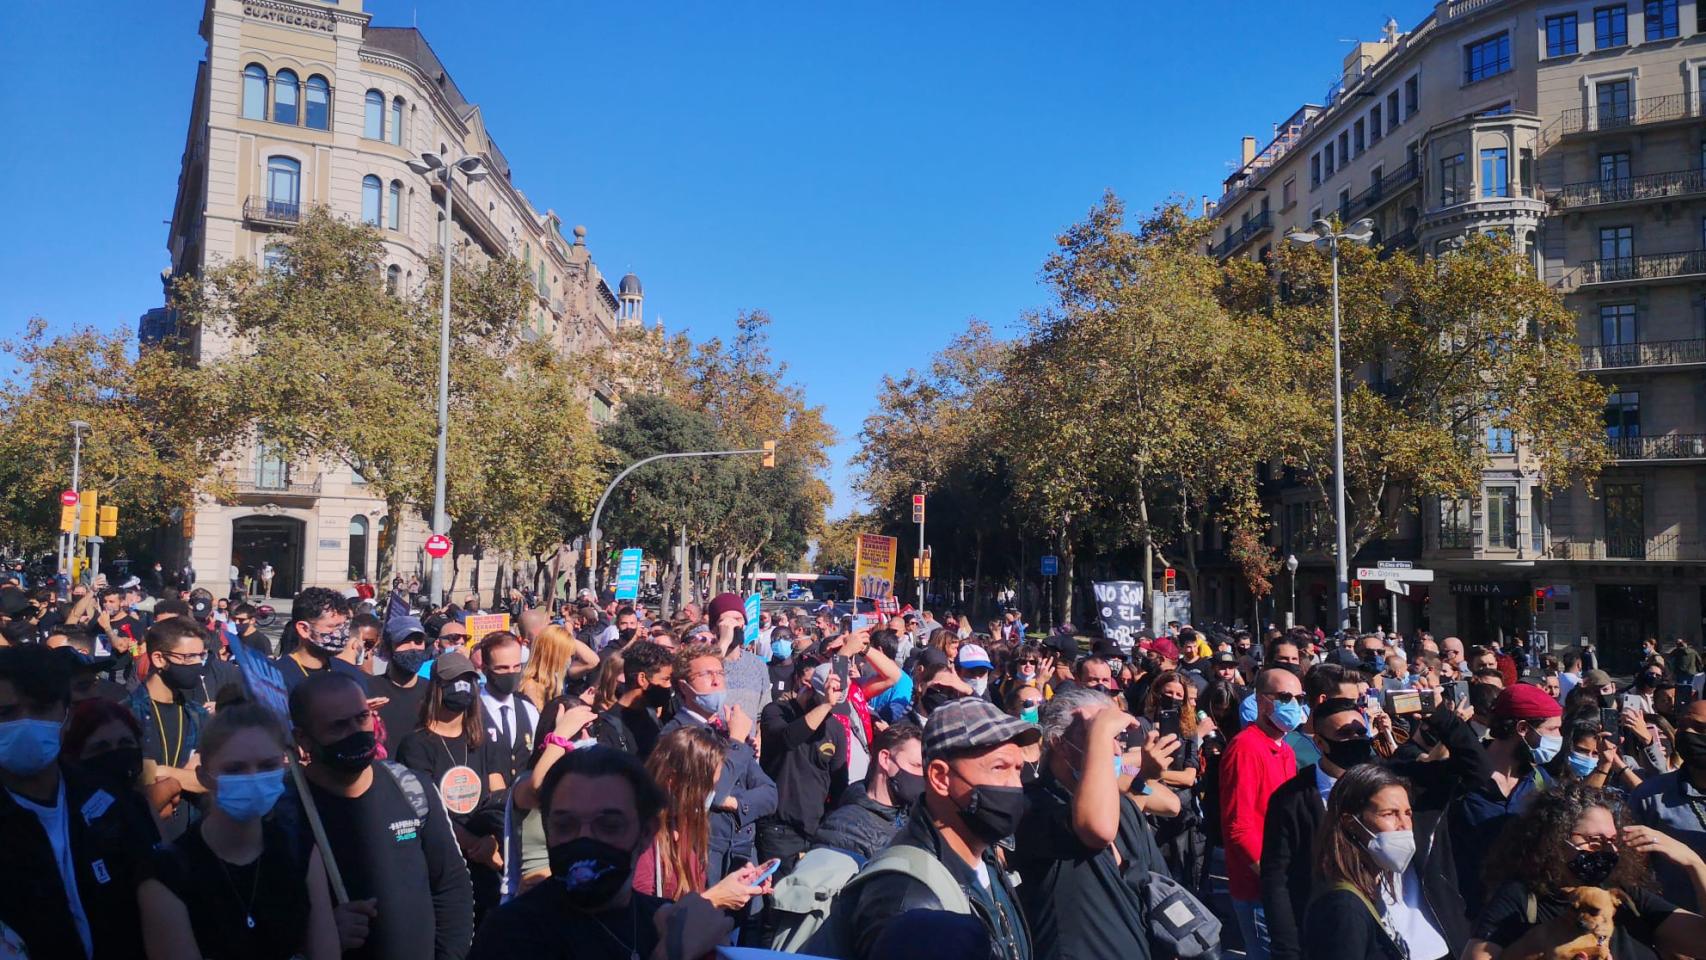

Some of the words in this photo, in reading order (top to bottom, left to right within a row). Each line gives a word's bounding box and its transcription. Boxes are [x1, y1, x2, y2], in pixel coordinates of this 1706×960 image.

[243, 7, 335, 32] CUATRECASAS
[1094, 584, 1117, 602] NO
[1118, 605, 1141, 620] EL
